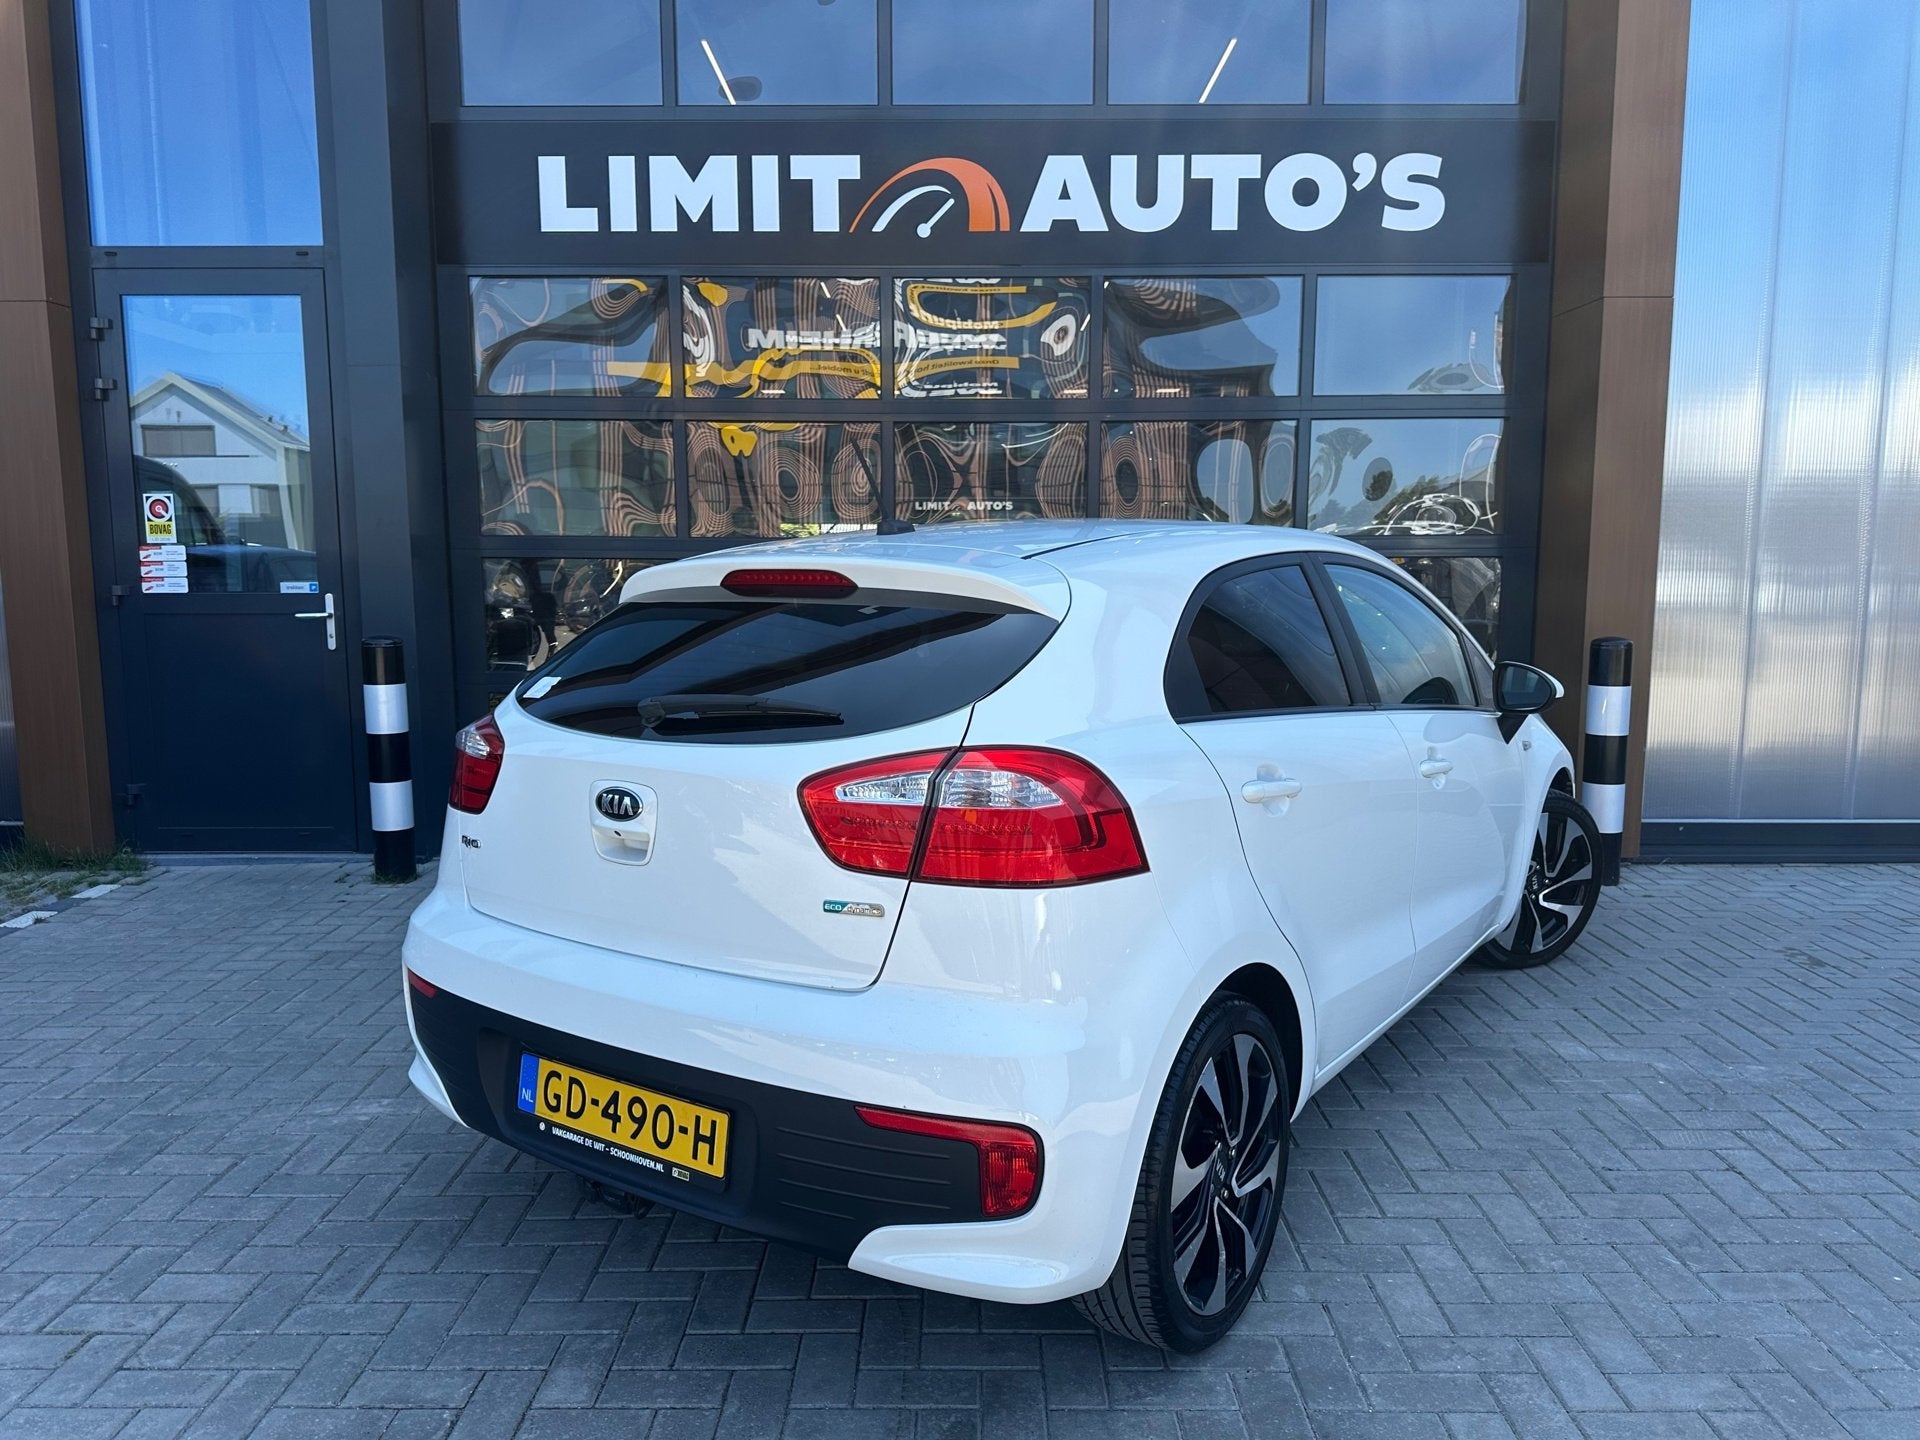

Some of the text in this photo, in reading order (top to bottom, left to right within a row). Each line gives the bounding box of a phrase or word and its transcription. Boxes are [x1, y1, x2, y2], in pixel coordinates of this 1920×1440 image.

[537, 153, 1446, 232] LIMIT AUTO'S
[915, 501, 1014, 511] LIMIT AUTO'S
[149, 523, 172, 535] BOVAG
[601, 793, 634, 816] KIA
[824, 903, 842, 911] ECO
[521, 1087, 534, 1103] NL
[543, 1069, 717, 1166] GD-490-H
[551, 1125, 585, 1146] VAKGARAGE
[584, 1138, 593, 1149] DE
[593, 1140, 605, 1152] WIT
[609, 1146, 665, 1173] SCHOONHOVEN.NL
